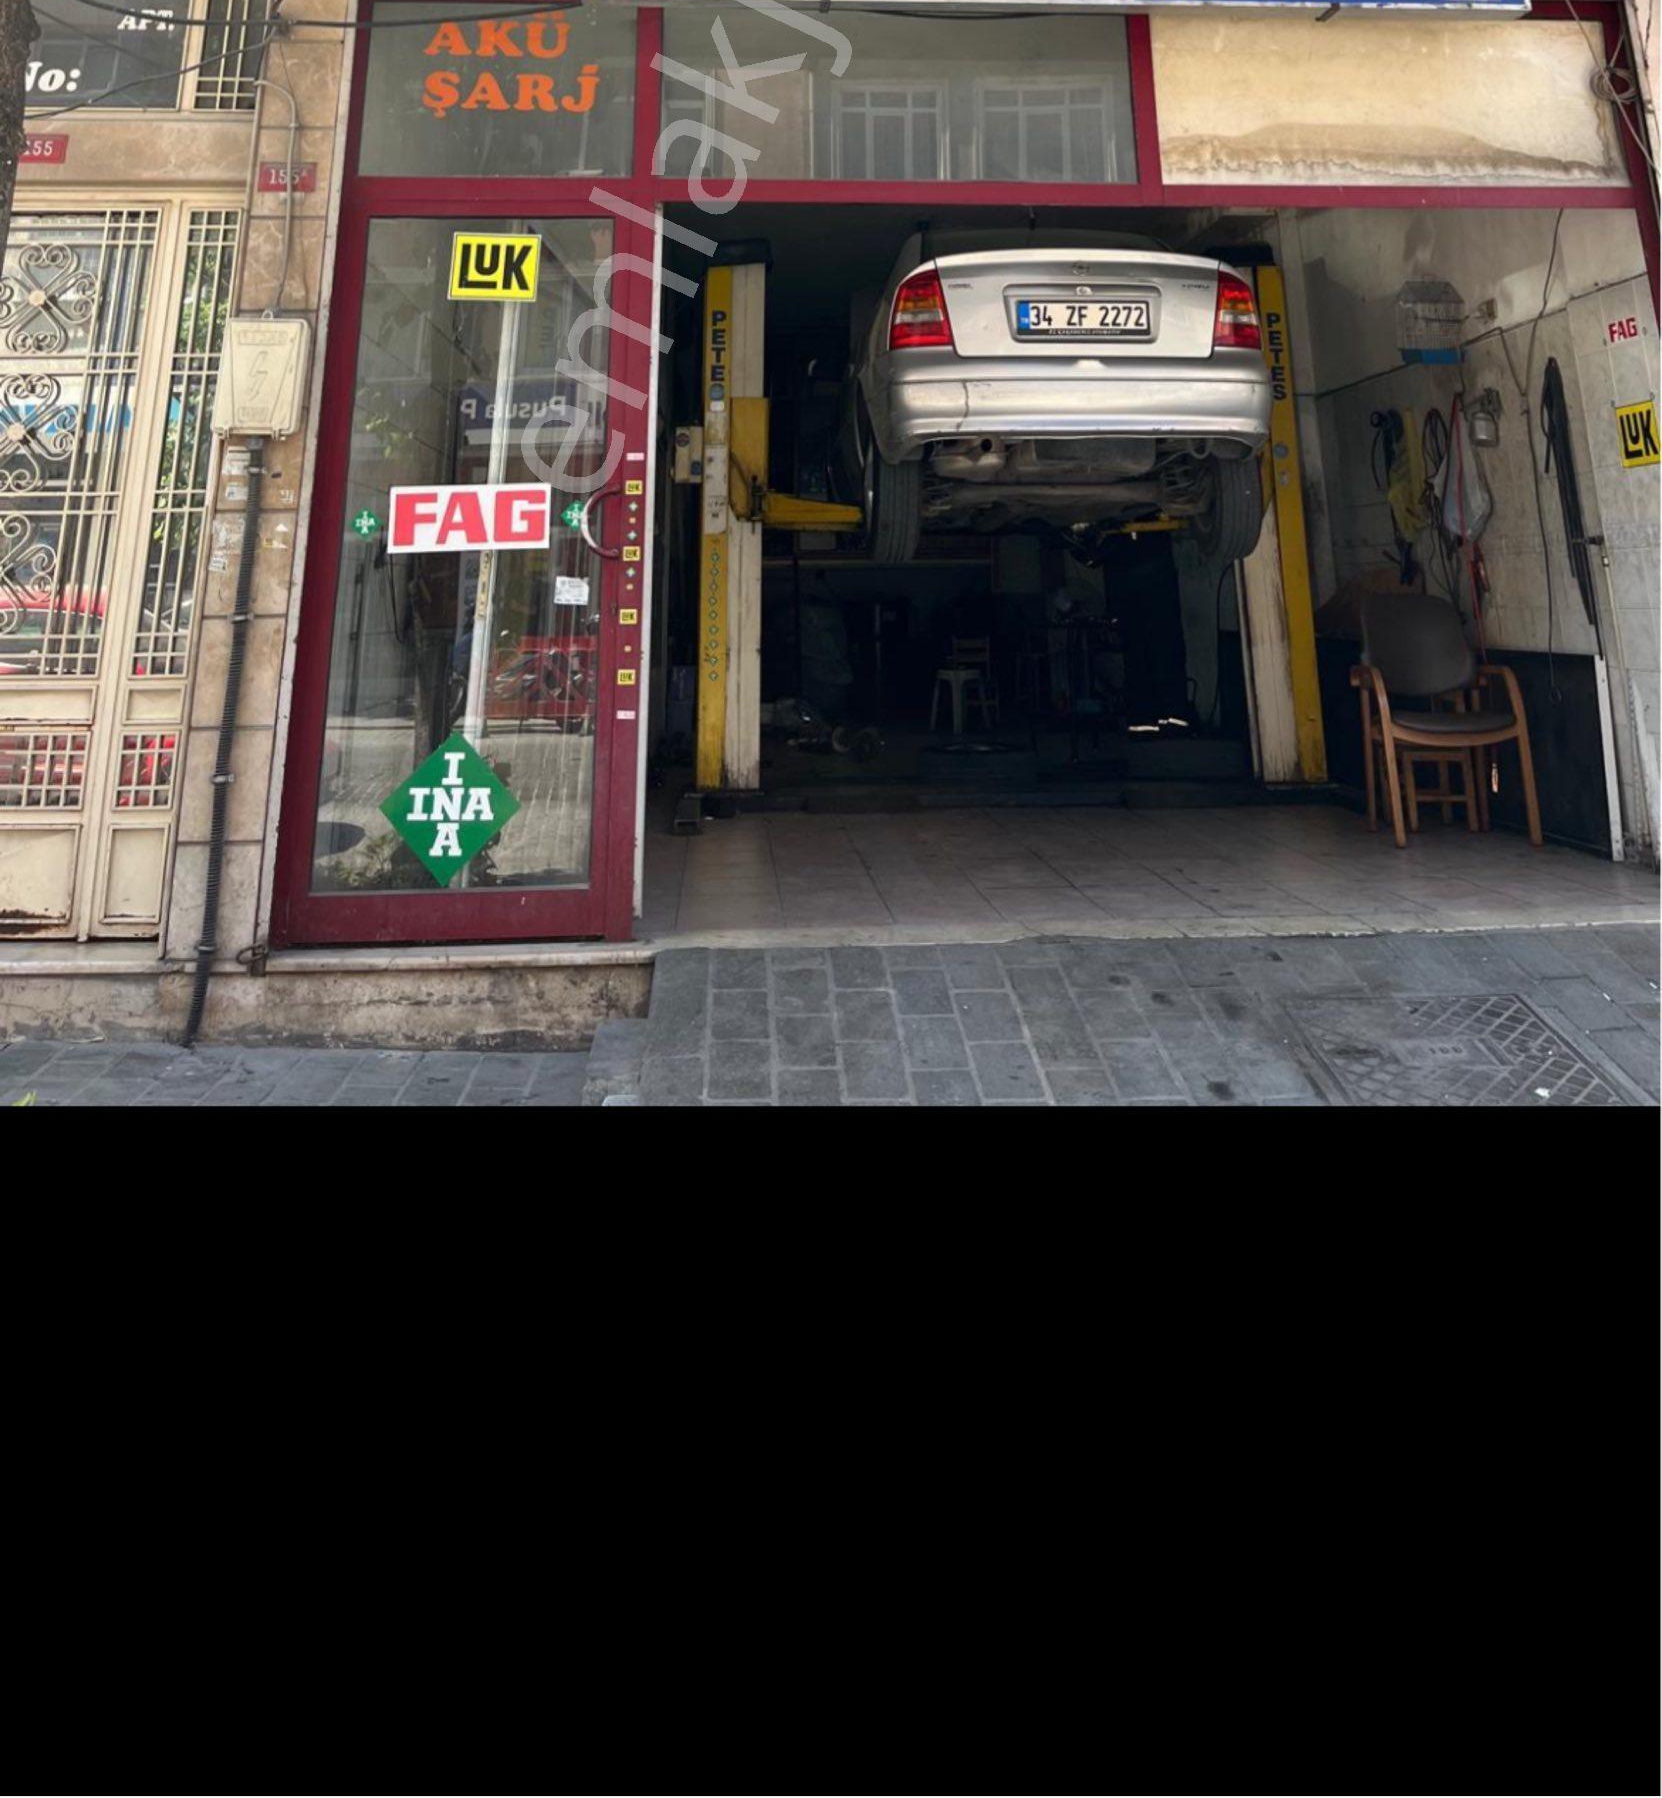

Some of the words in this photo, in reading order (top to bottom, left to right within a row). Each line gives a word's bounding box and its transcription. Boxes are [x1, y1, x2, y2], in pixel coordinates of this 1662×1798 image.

[423, 11, 571, 59] AKÜ
[422, 64, 600, 119] ŞARJ
[458, 243, 533, 291] LUK
[1030, 305, 1053, 326] 34
[1066, 305, 1088, 326] ZF
[1099, 305, 1145, 327] 2272
[1608, 317, 1638, 343] FAG
[711, 310, 727, 400] PETE
[1267, 312, 1287, 401] PETES
[1619, 409, 1659, 459] LUK
[393, 489, 546, 546] FAG
[406, 787, 494, 821] INA
